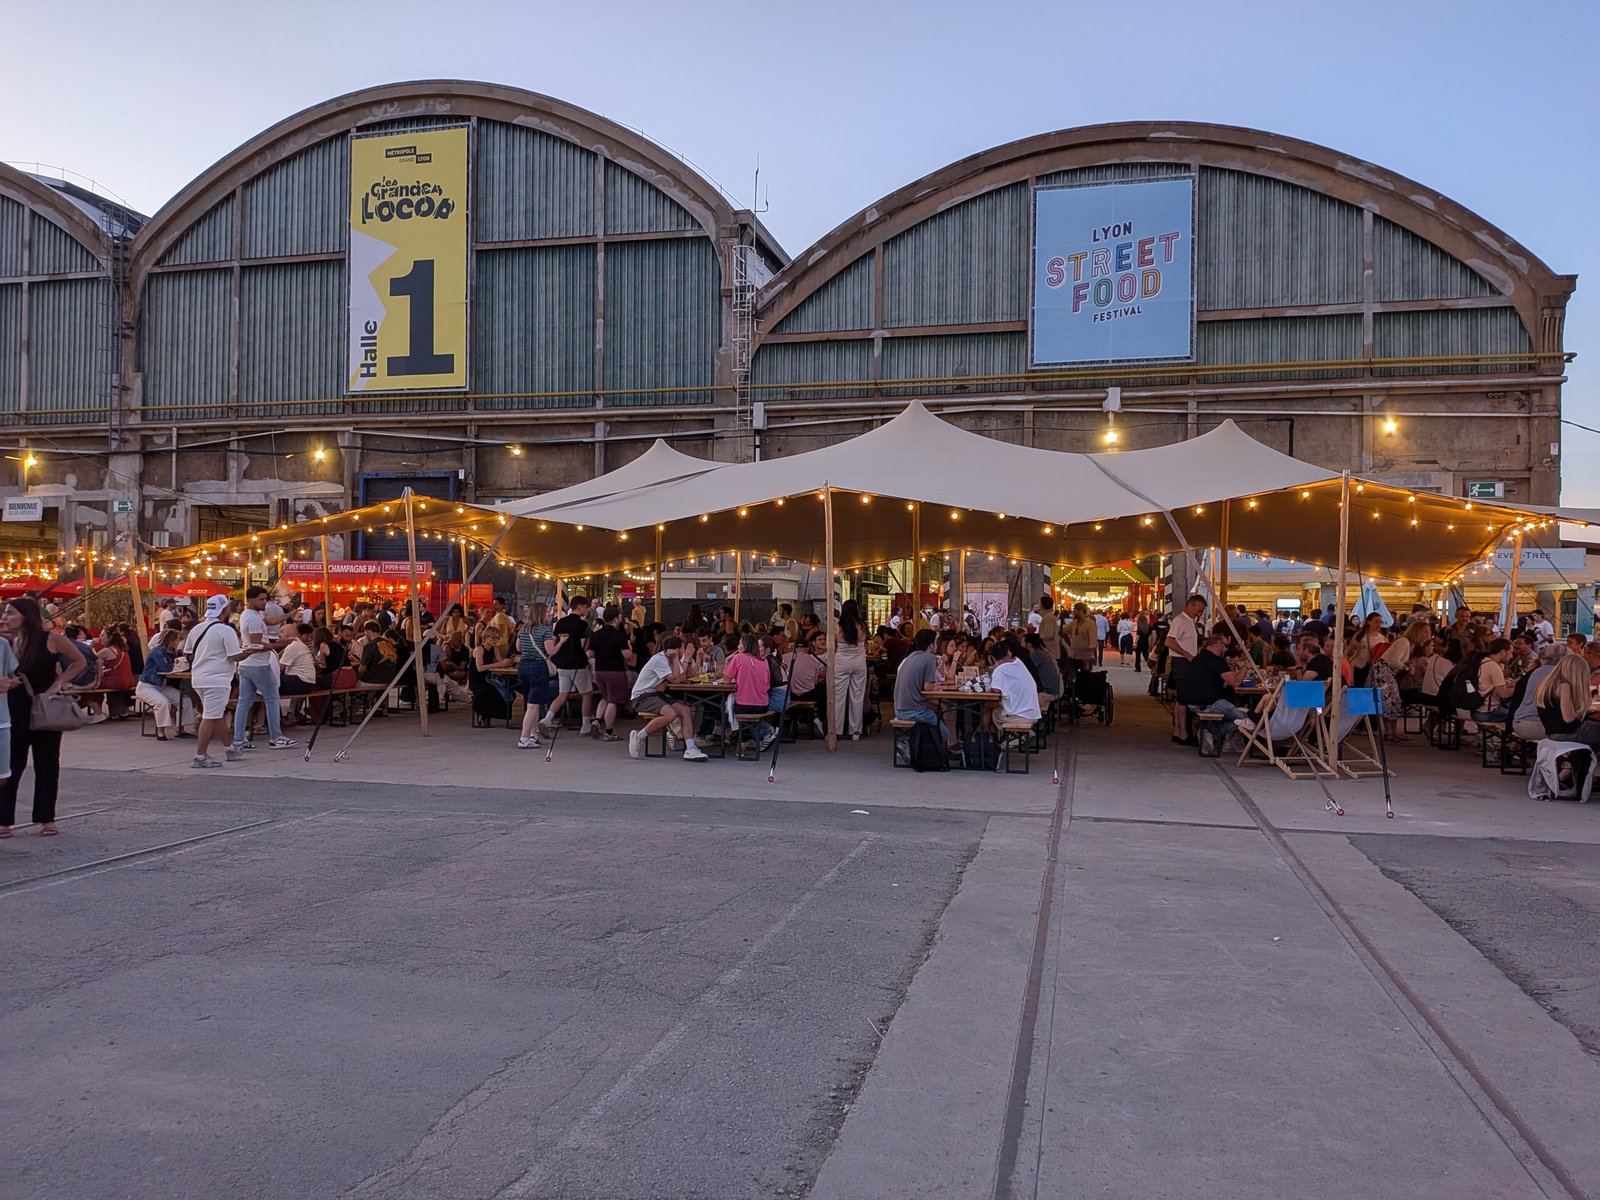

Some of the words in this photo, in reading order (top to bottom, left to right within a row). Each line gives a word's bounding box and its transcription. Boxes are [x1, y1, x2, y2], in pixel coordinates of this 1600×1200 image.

[387, 148, 415, 156] METROPOLE
[1093, 221, 1133, 242] LYON
[1047, 231, 1180, 287] STREET
[1072, 268, 1161, 313] FOOD
[387, 259, 454, 376] 1
[1093, 305, 1143, 323] FESTIVAL
[360, 320, 377, 377] Halle
[8, 502, 38, 510] BIENVENUE
[1497, 551, 1552, 559] EVE-TREE
[328, 564, 367, 573] CHAMPAGNE
